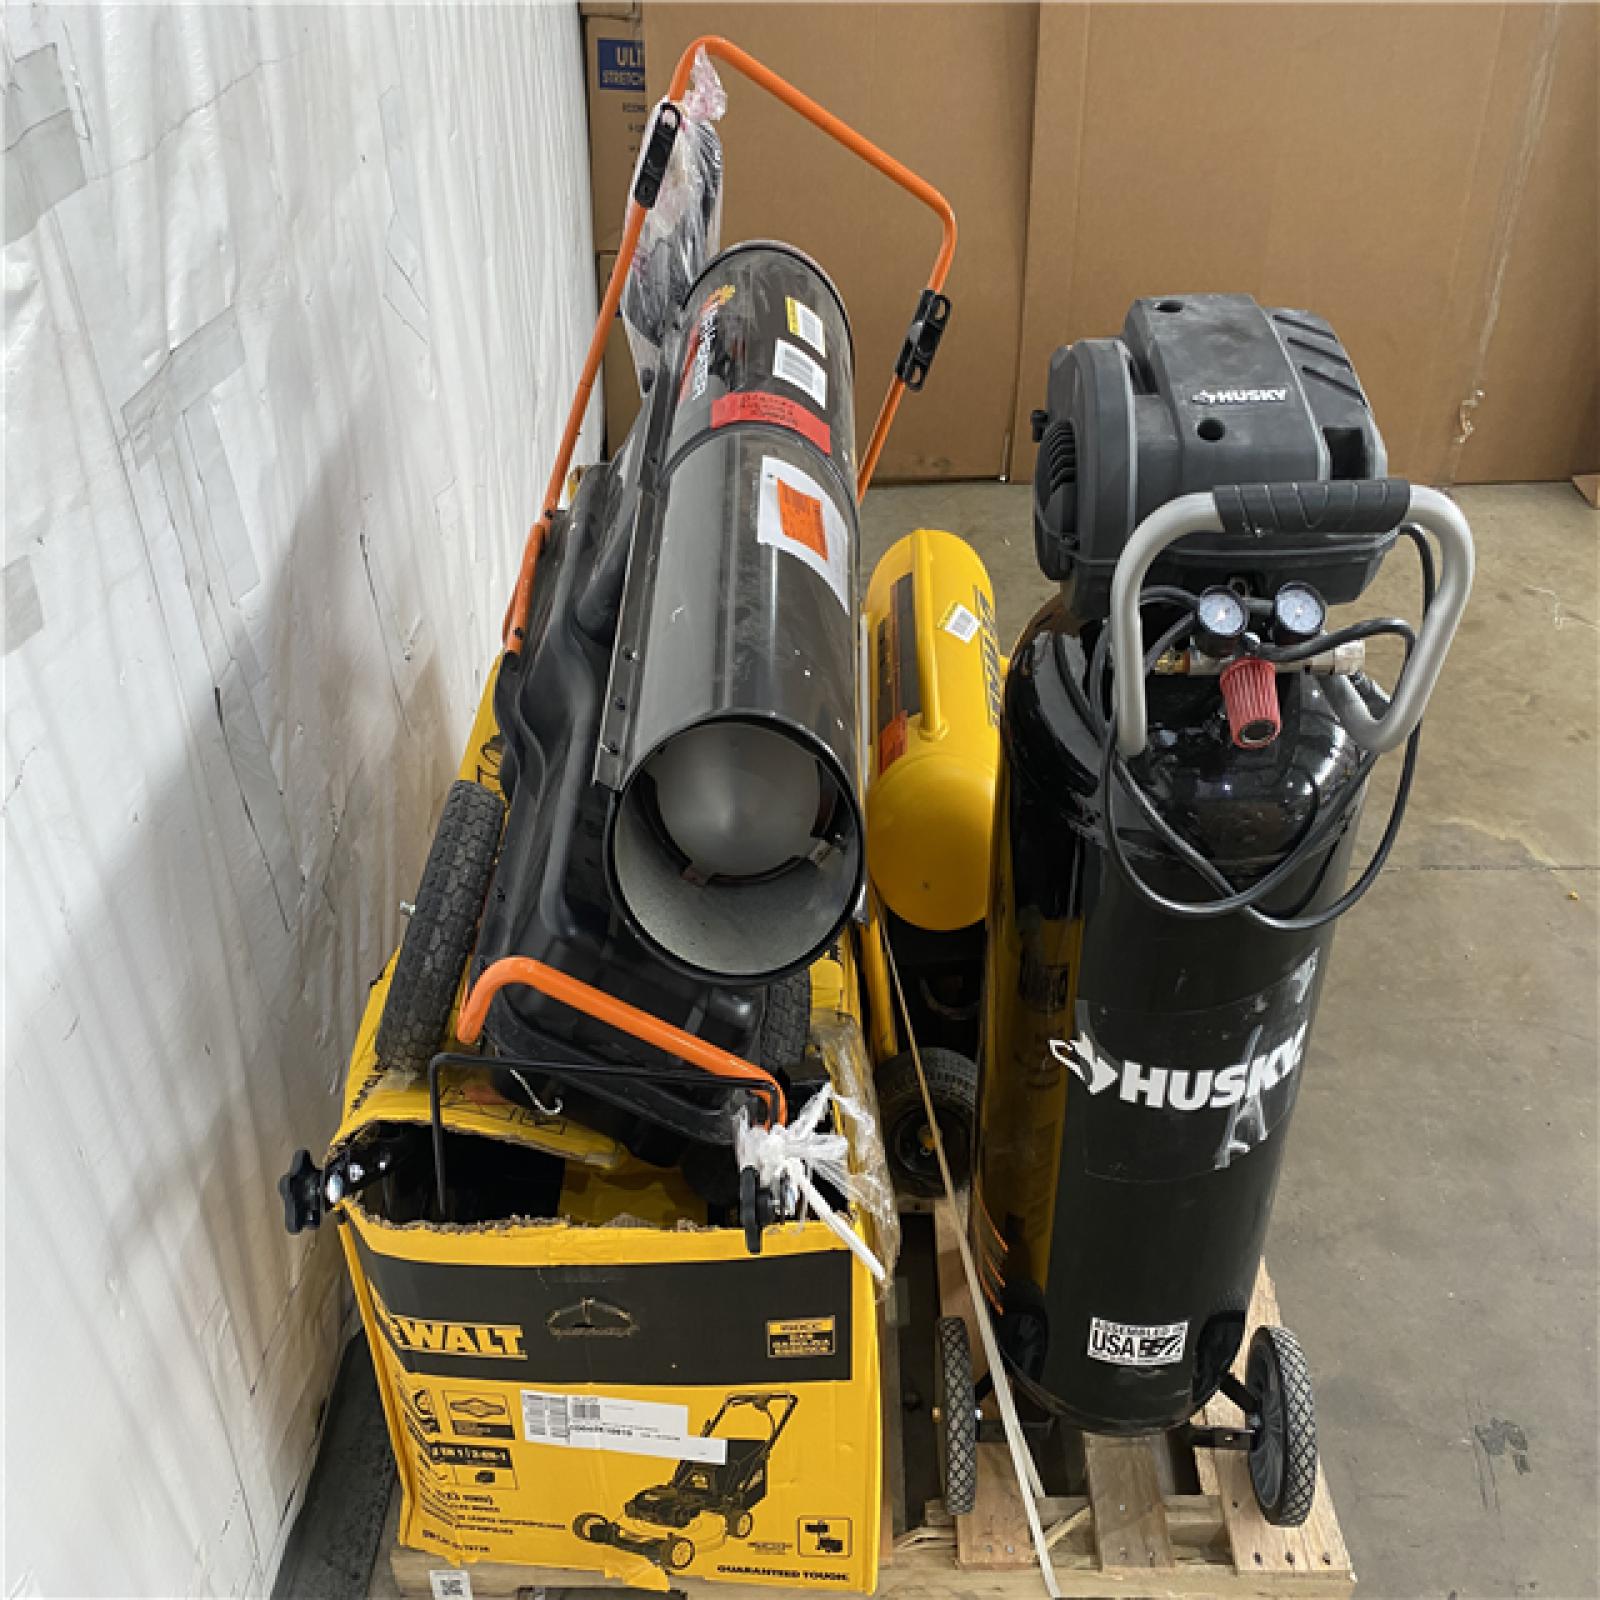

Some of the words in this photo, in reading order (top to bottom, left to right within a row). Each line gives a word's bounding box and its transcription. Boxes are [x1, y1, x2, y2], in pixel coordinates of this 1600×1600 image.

[1217, 389, 1286, 404] HUSKY
[1119, 1020, 1308, 1110] HUSKY
[1093, 1330, 1134, 1356] USA
